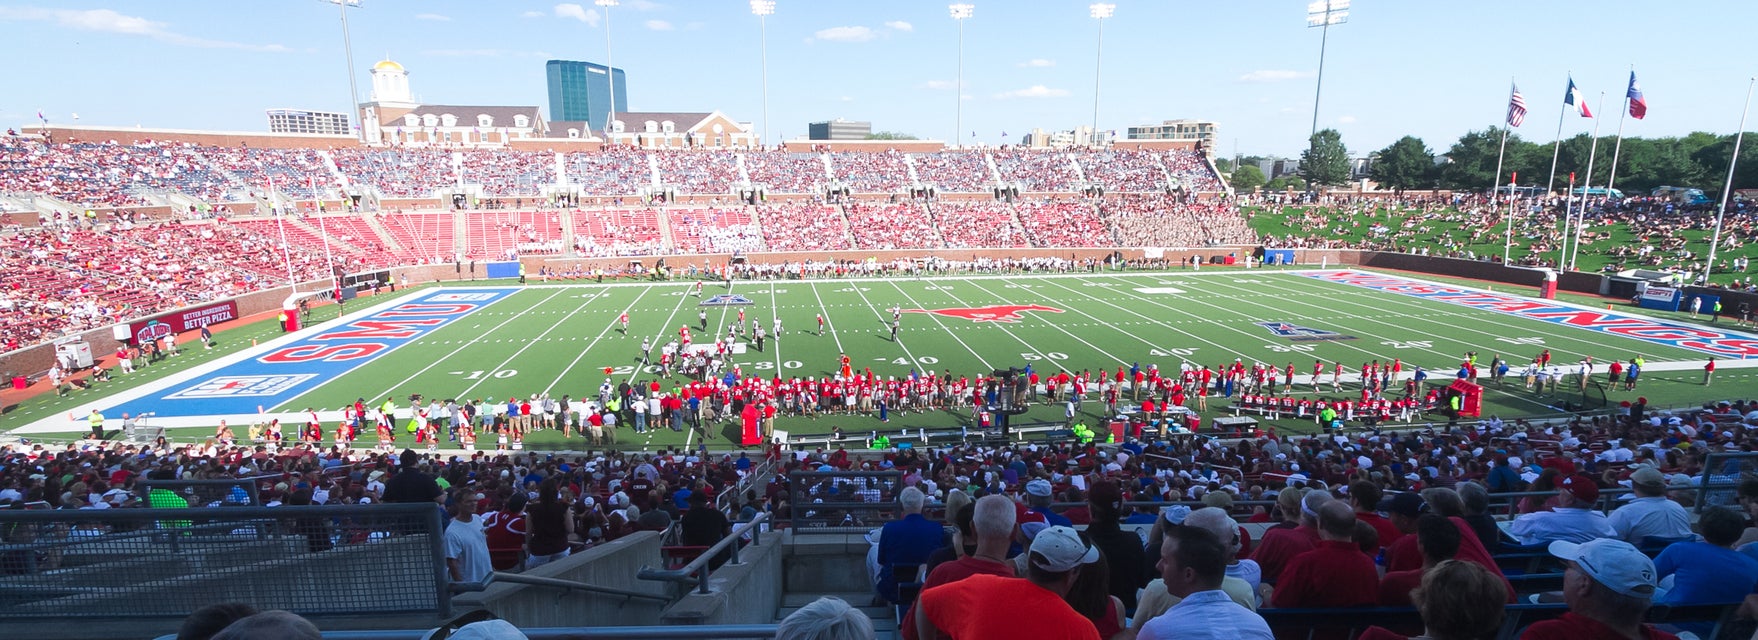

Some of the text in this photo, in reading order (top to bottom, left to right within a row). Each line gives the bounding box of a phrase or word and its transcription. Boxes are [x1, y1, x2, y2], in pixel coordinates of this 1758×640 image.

[1646, 289, 1673, 297] ESPN
[183, 311, 201, 320] BETTER
[184, 318, 211, 329] BETTER
[257, 304, 479, 363] SMU
[1021, 352, 1069, 360] 50
